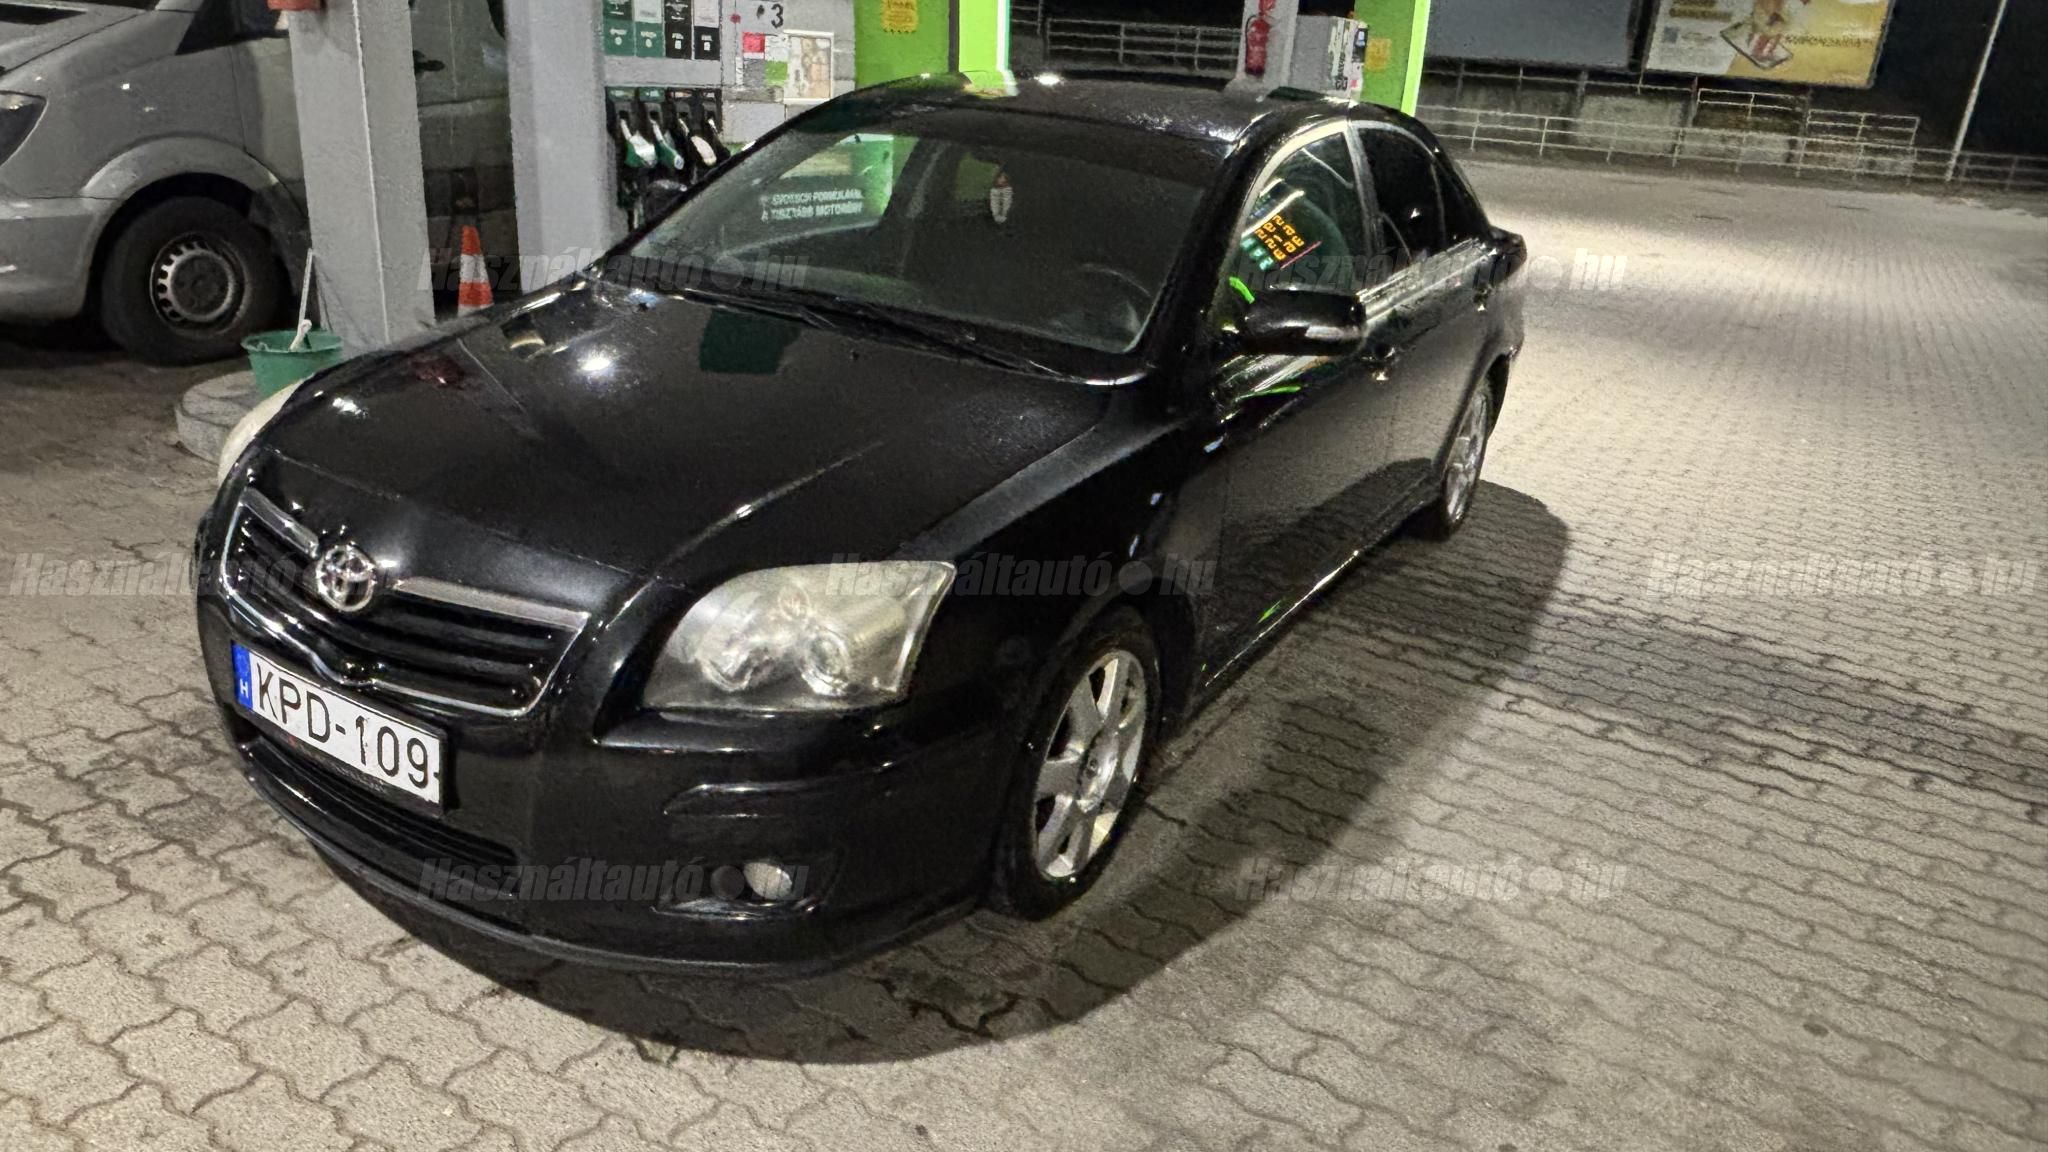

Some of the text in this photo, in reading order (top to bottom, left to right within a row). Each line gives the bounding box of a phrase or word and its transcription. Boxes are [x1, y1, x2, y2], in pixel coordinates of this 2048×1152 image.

[771, 3, 784, 29] 3
[239, 679, 249, 699] H
[257, 662, 429, 789] KPD-109
